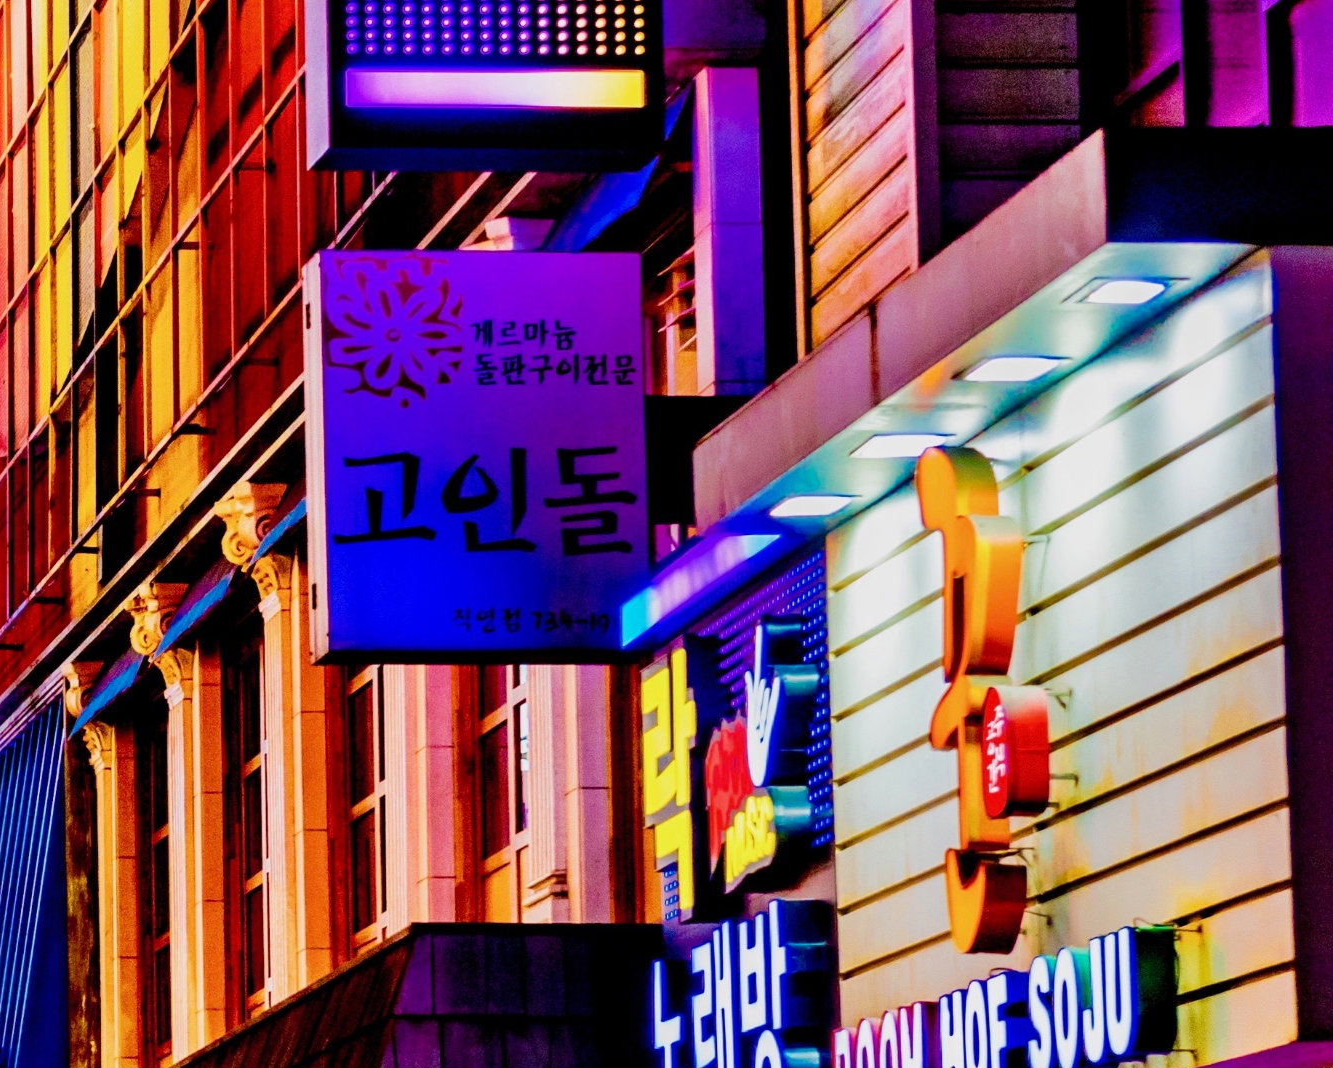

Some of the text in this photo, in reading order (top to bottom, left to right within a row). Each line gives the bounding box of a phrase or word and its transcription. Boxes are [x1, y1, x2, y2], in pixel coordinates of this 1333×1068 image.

[471, 319, 577, 351] 게르마늄
[472, 353, 638, 387] 돌판구이전문
[334, 445, 638, 557] 고인돌
[642, 648, 697, 911] 락
